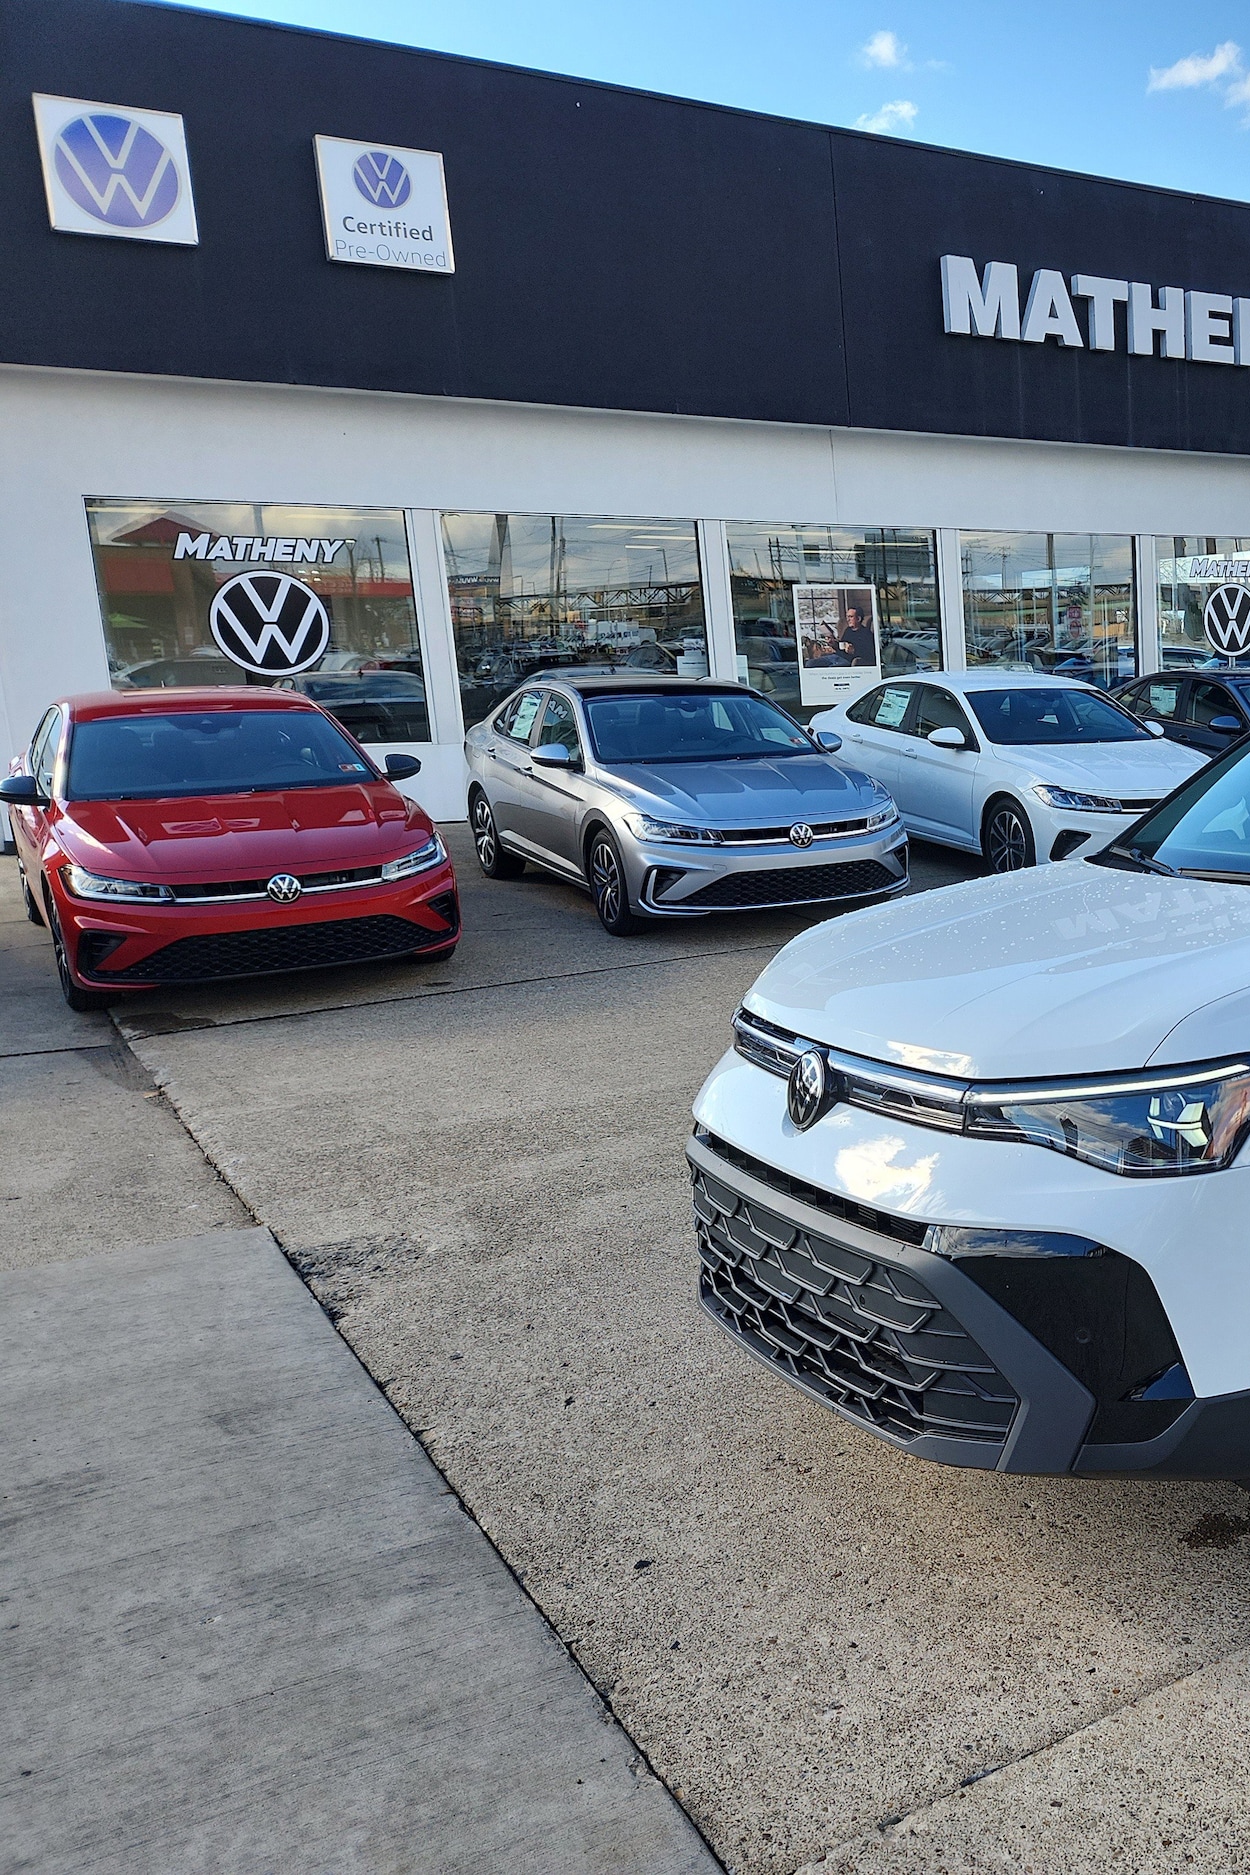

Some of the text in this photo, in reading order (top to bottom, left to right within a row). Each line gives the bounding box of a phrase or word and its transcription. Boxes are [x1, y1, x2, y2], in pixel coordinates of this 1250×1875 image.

[342, 216, 434, 241] Certified
[335, 239, 447, 267] Pre-Owned
[173, 532, 346, 563] MATHENY
